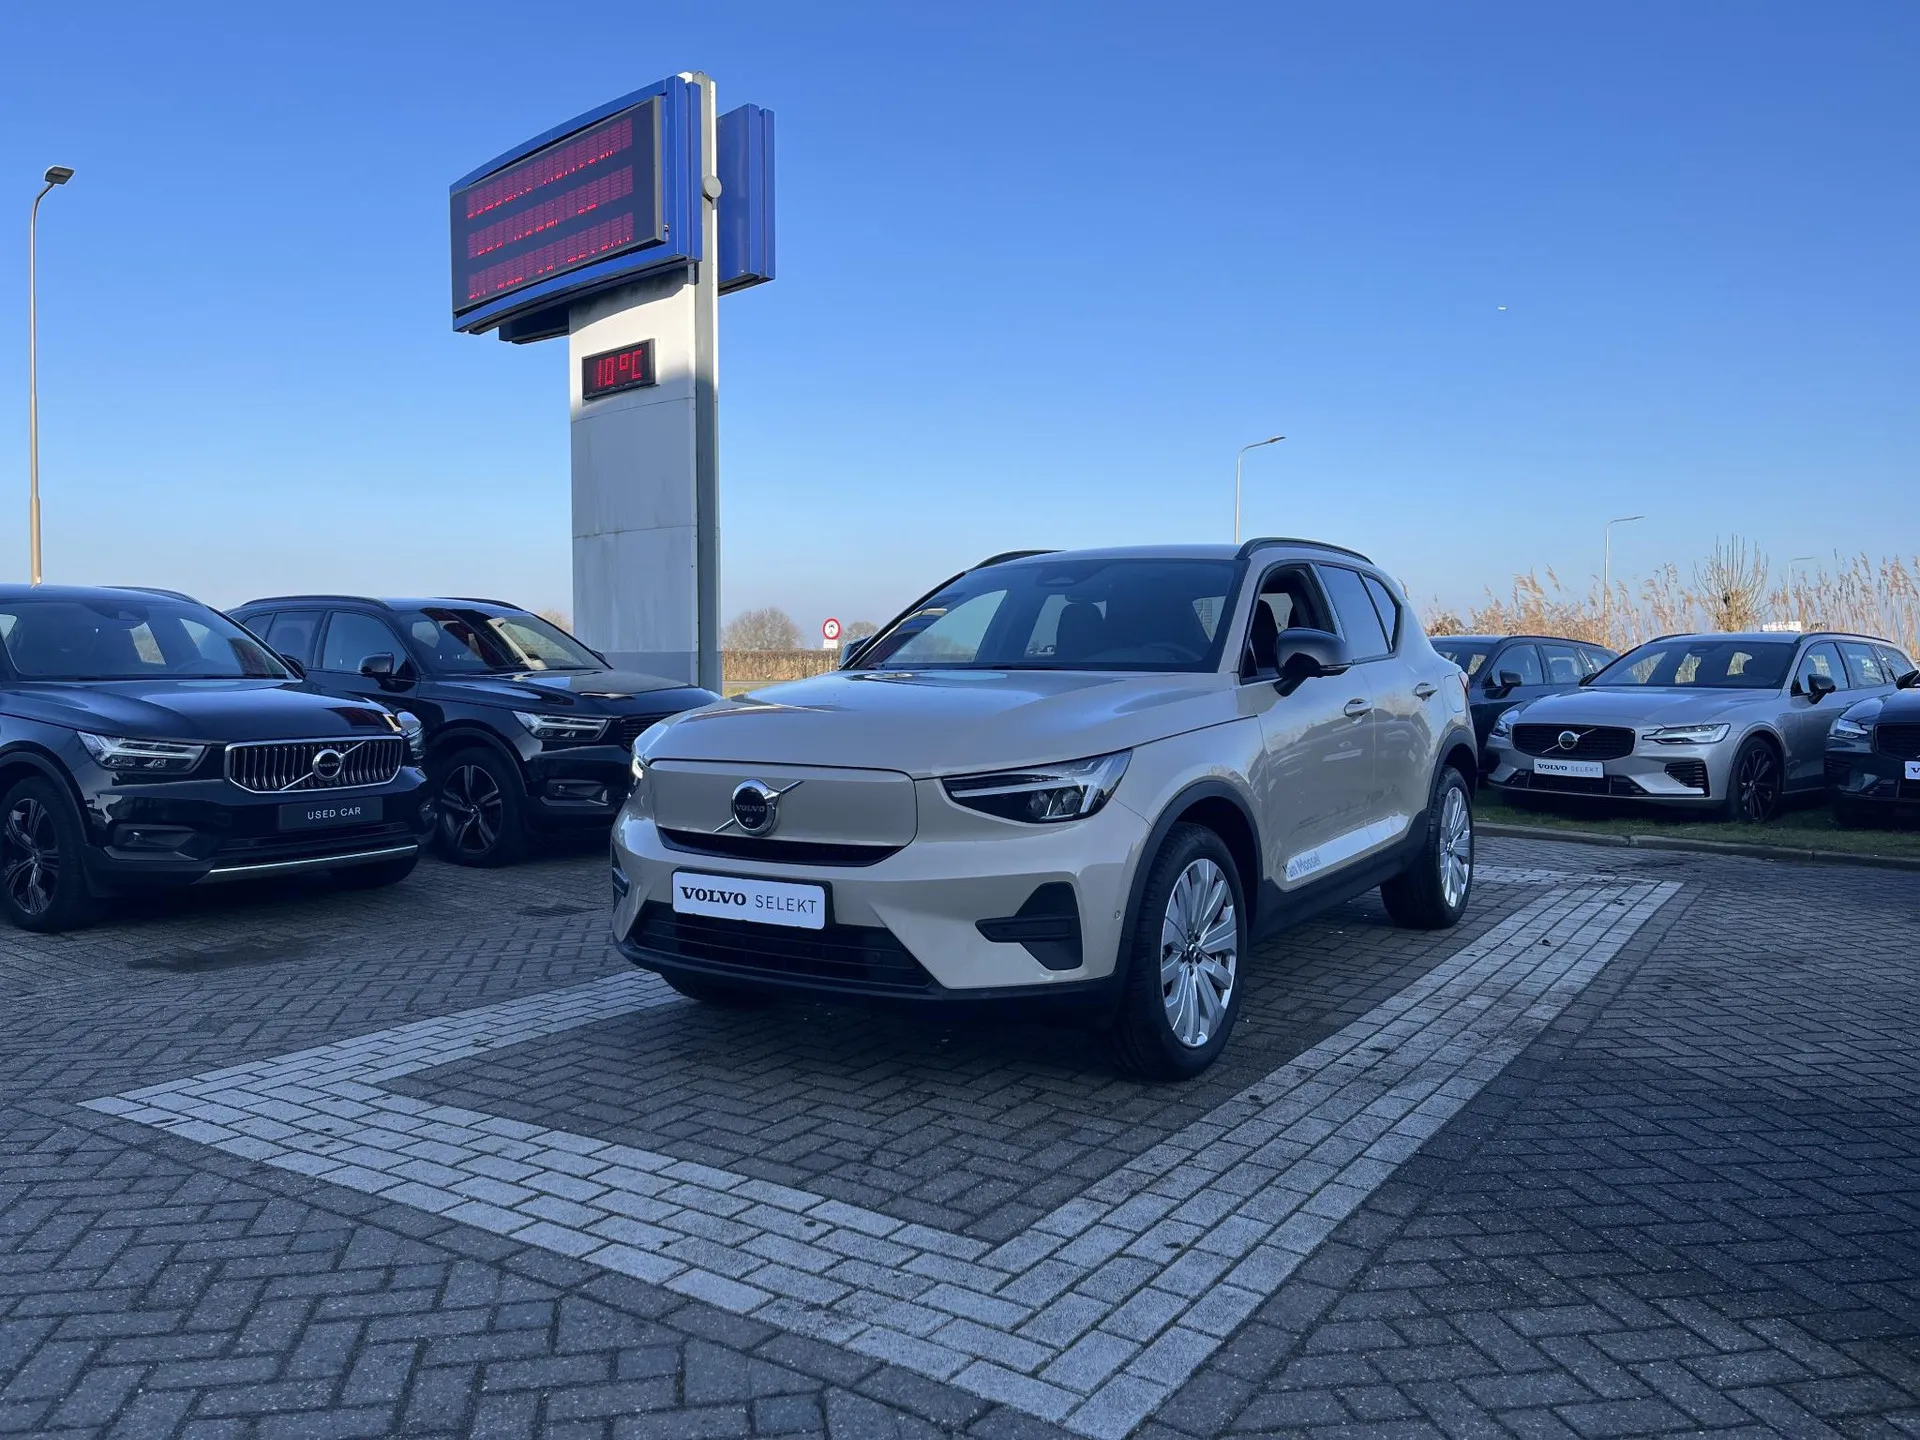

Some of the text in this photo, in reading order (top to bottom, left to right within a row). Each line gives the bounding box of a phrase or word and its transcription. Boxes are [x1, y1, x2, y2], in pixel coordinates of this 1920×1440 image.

[1537, 763, 1600, 774] VOLVO SELEKT
[307, 806, 361, 820] USED CAR
[735, 803, 766, 812] VOLVO
[679, 886, 817, 914] VOLVO SELEKT
